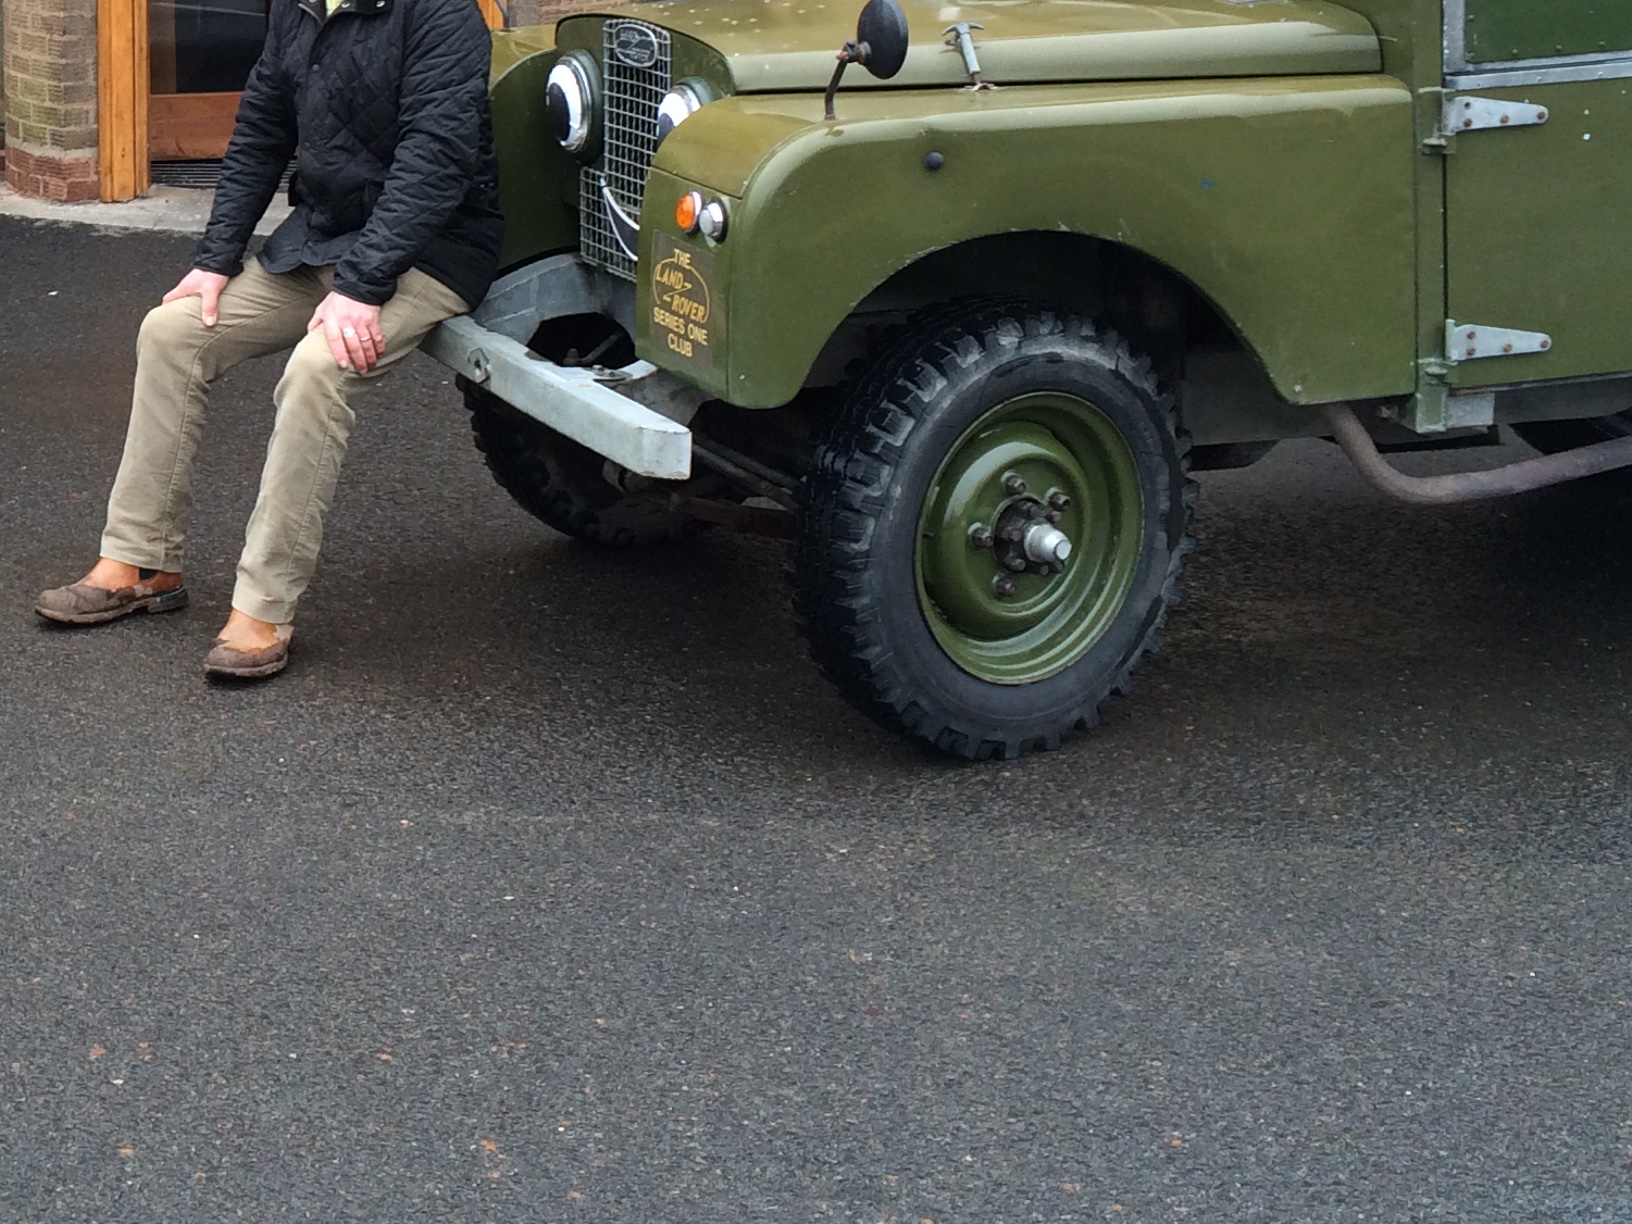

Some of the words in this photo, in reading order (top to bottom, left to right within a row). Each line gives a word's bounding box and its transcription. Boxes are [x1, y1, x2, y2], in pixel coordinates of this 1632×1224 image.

[674, 248, 691, 267] THE
[655, 264, 684, 289] LAND
[671, 295, 705, 323] ROVER
[653, 307, 686, 334] SERIES
[687, 323, 708, 346] ONE
[667, 333, 693, 358] CLUB
